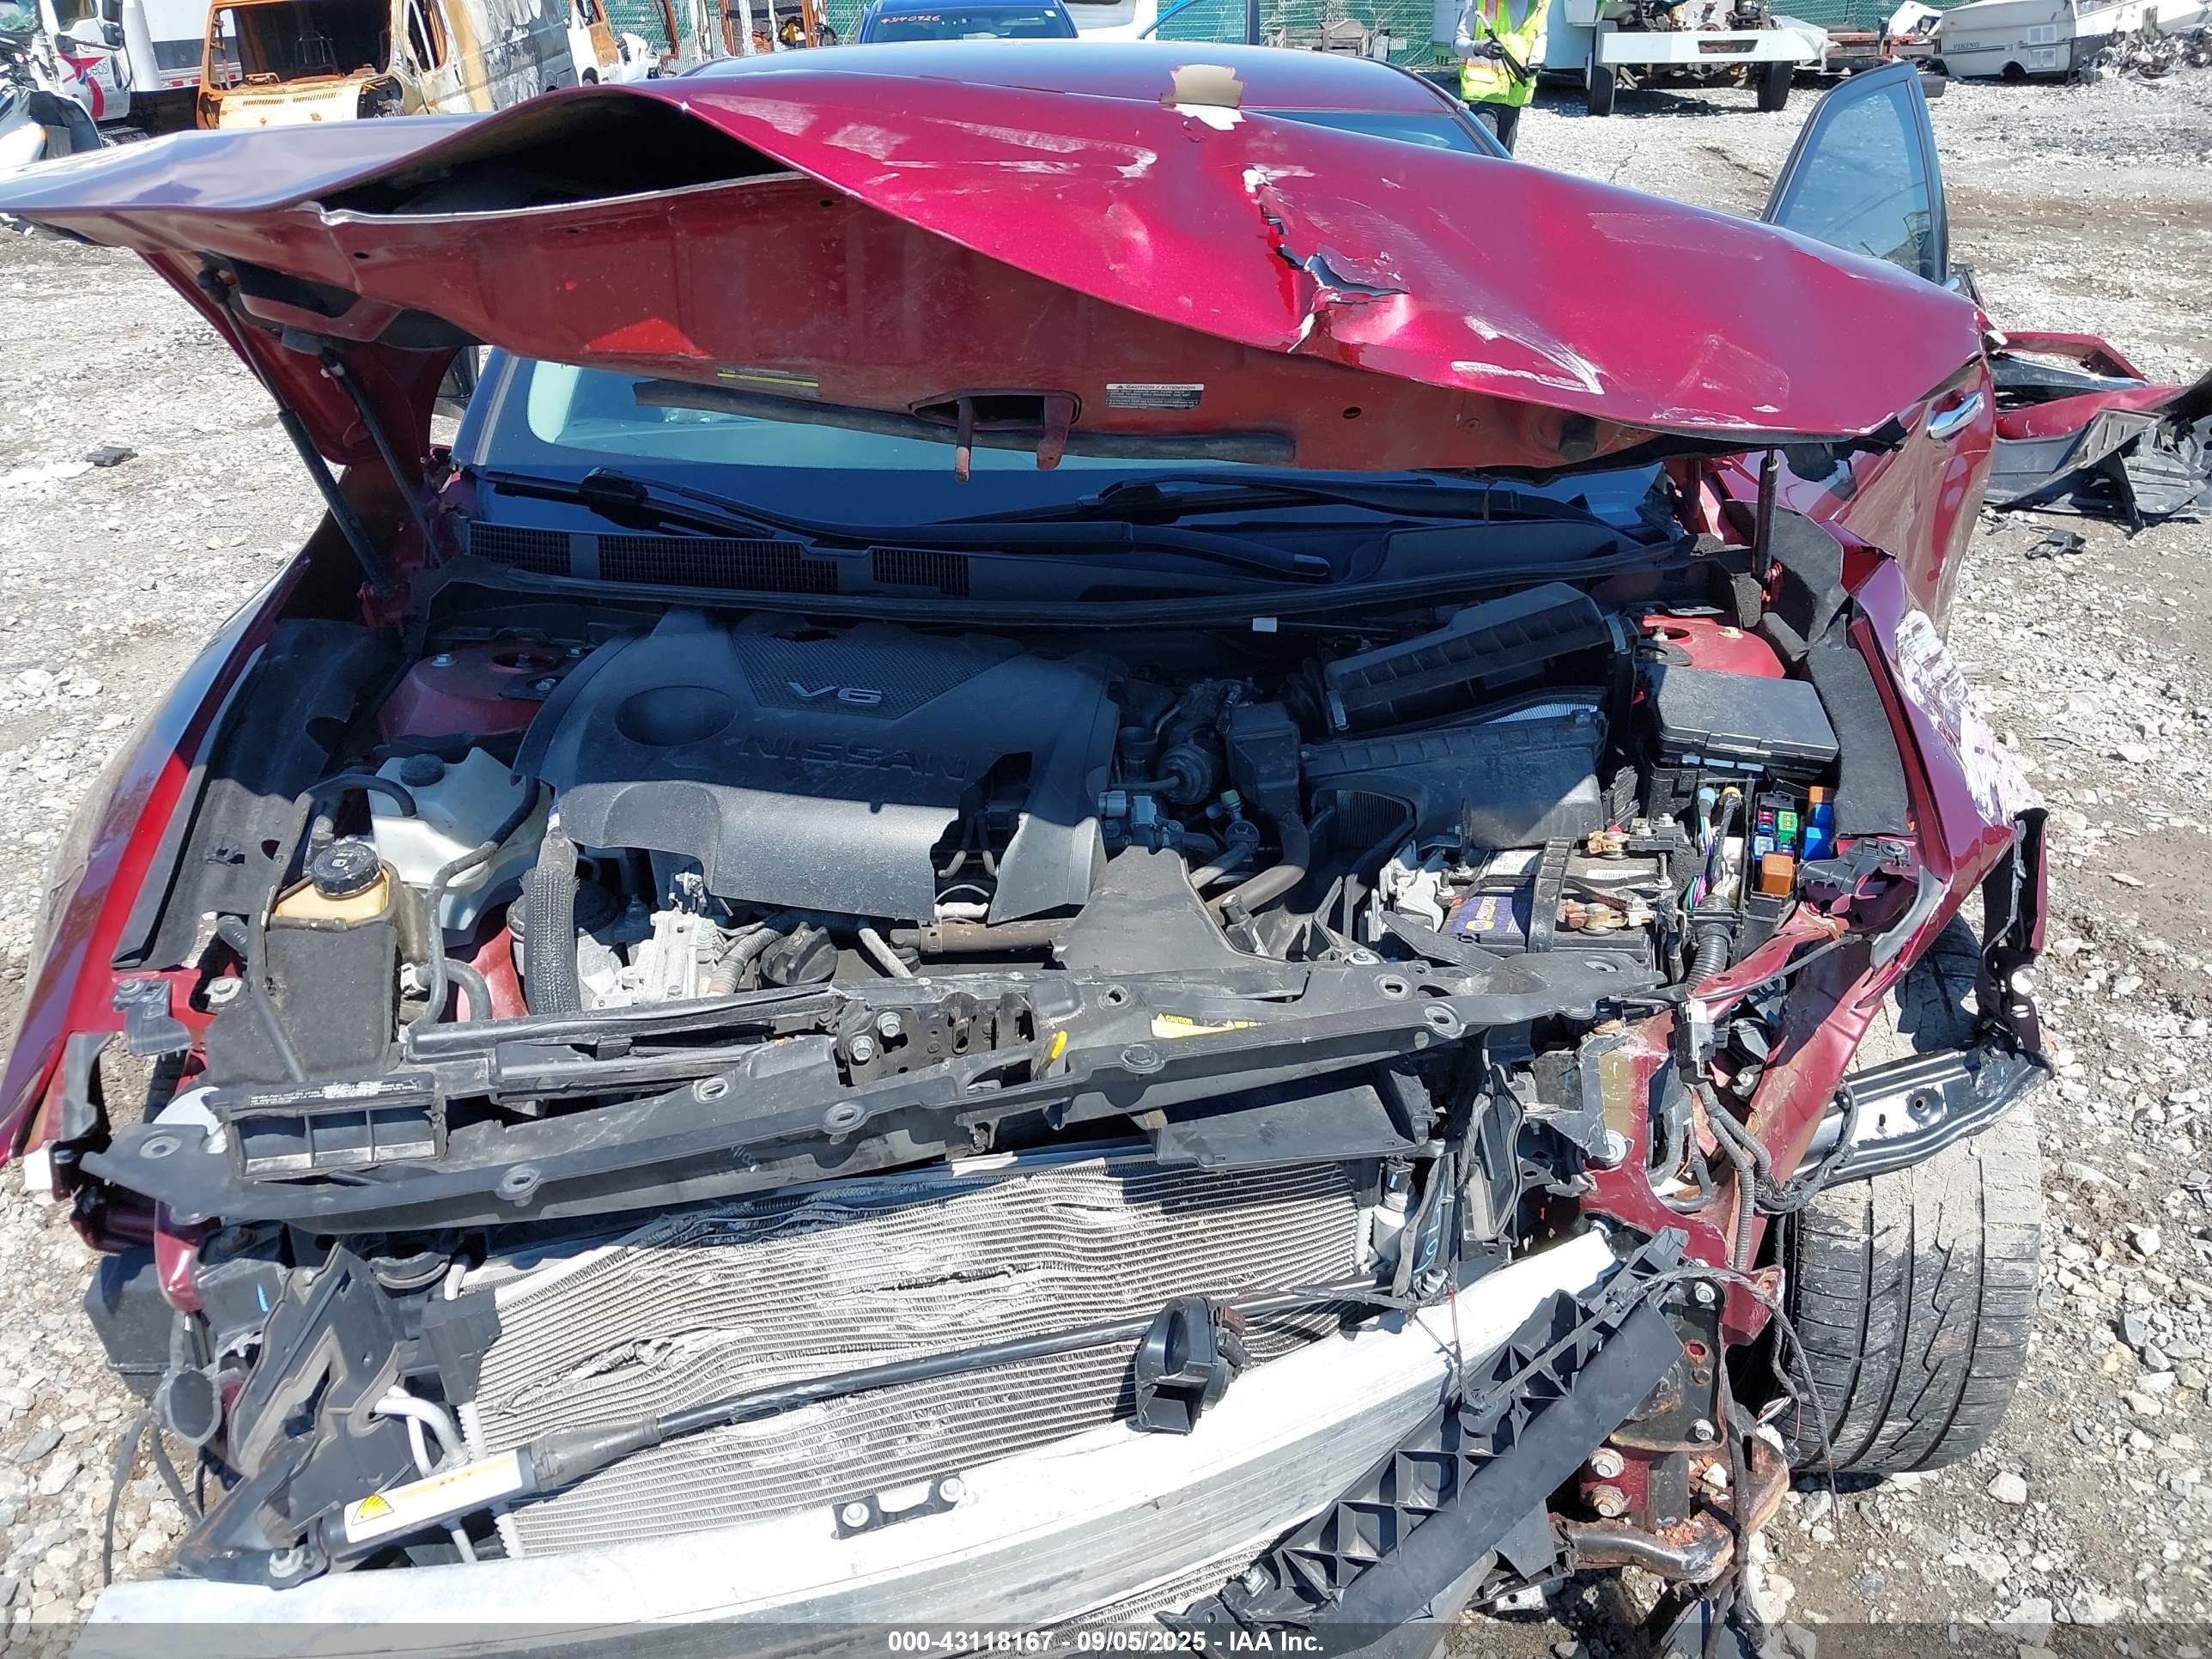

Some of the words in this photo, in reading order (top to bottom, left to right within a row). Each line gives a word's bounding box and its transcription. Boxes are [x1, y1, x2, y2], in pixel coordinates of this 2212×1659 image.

[788, 682, 882, 706] V6
[738, 733, 972, 783] NISSAN
[1165, 1015, 1193, 1024] CAUTION
